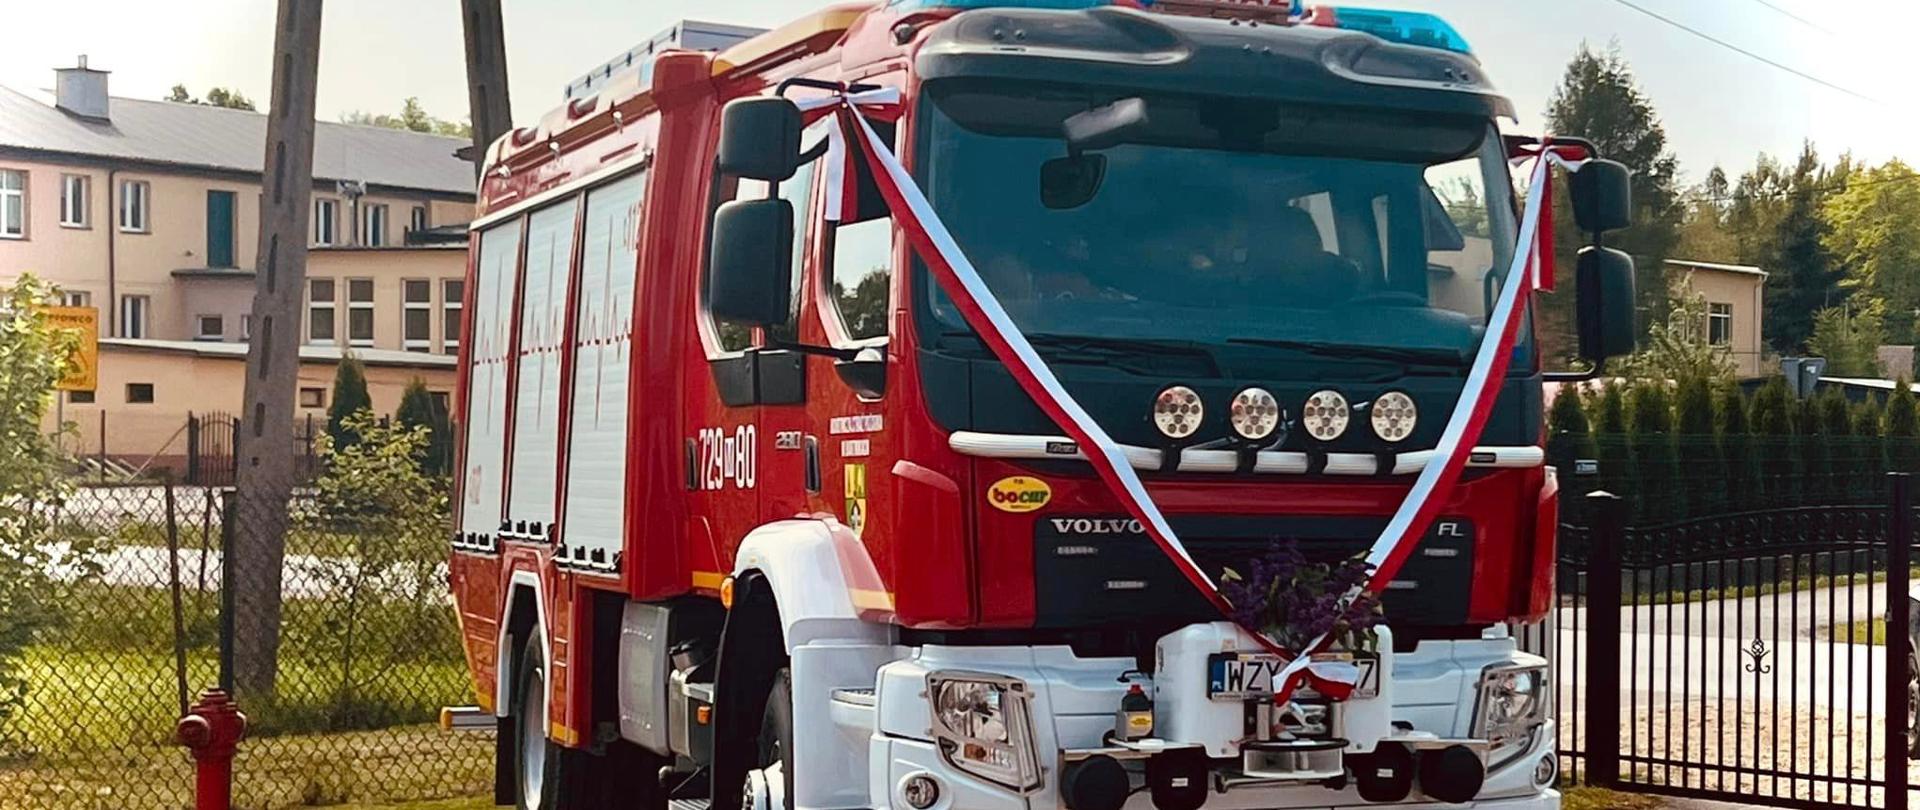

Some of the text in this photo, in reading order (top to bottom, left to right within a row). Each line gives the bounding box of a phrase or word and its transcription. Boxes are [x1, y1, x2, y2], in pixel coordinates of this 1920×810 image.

[699, 427, 723, 489] 729
[736, 424, 755, 488] 80
[1051, 518, 1146, 534] VOLVO
[1438, 522, 1464, 536] FL
